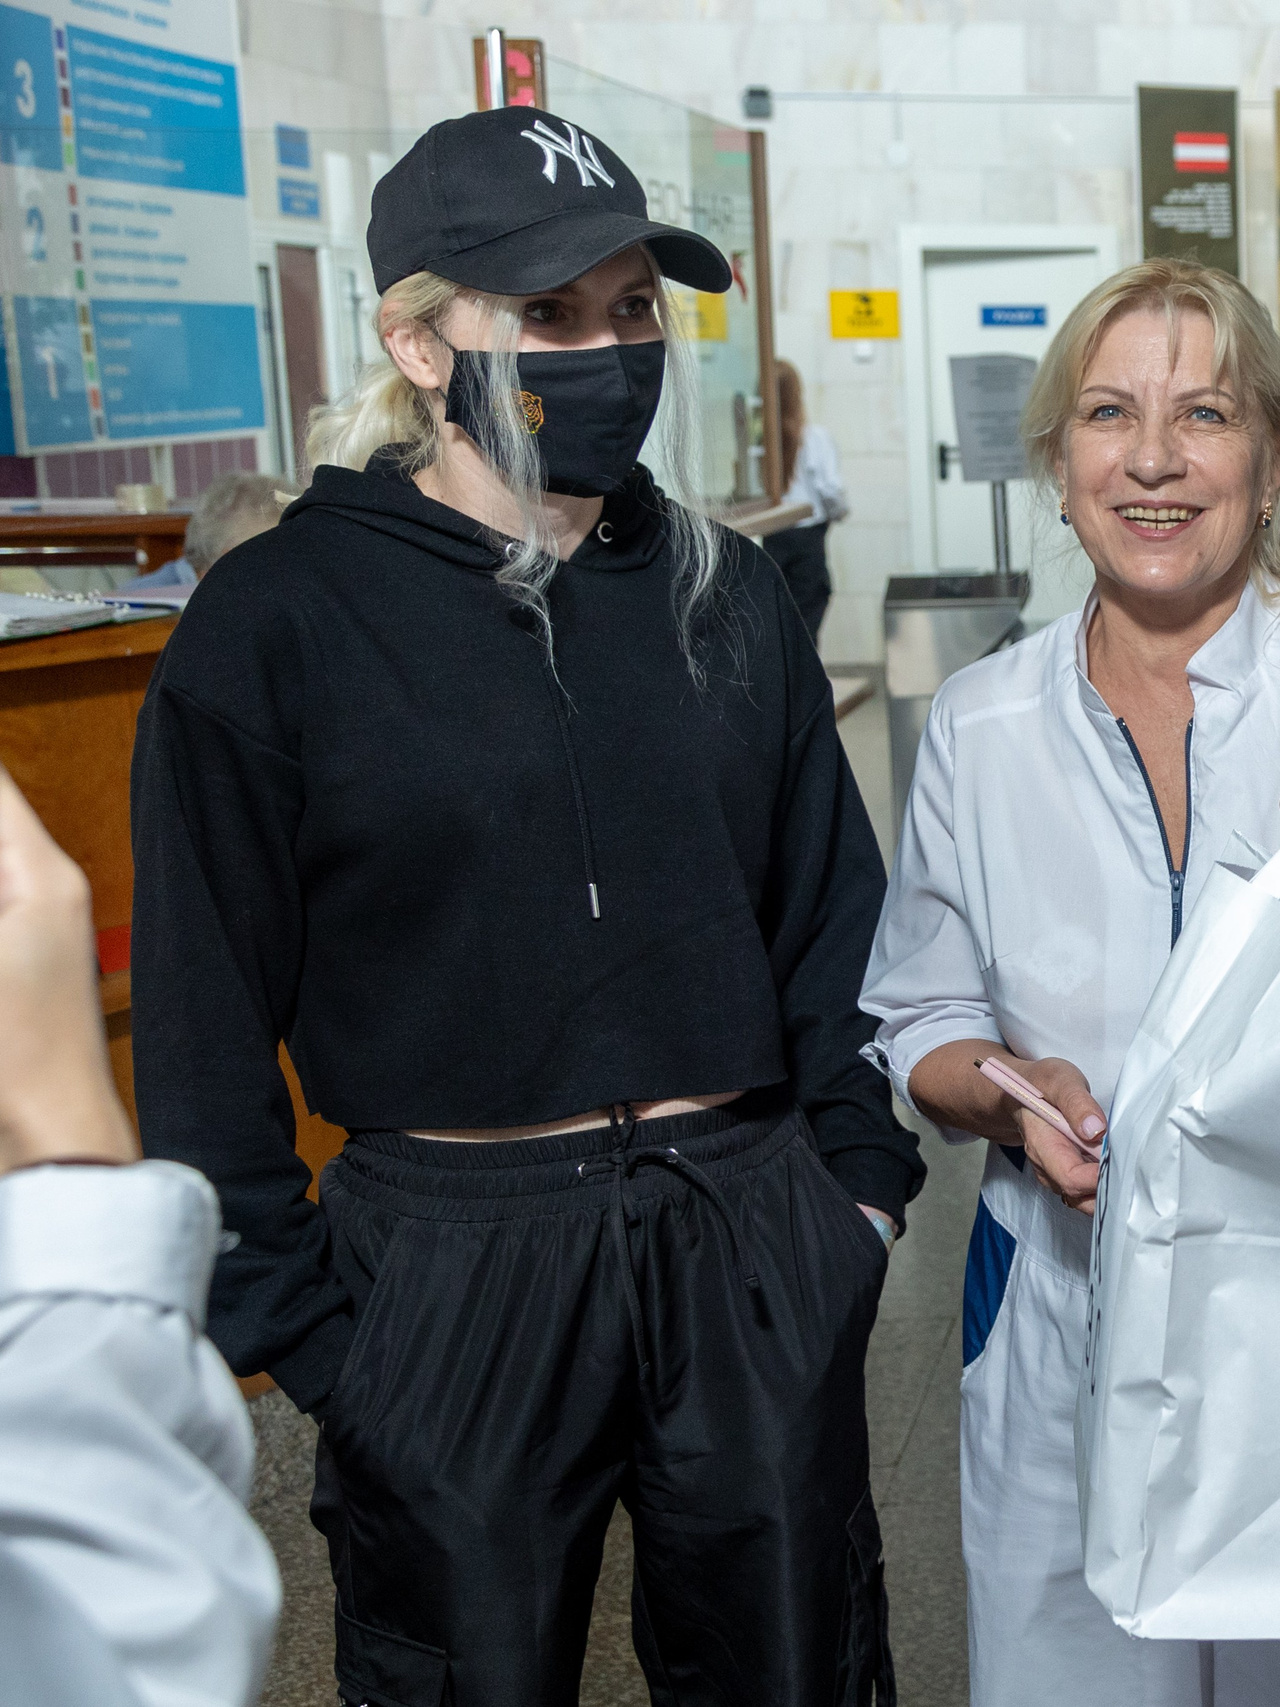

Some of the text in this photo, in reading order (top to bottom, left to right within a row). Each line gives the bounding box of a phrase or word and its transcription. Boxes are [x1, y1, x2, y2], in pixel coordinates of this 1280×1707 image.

[14, 59, 36, 119] 3
[520, 119, 616, 189] NY
[26, 206, 47, 262] 2
[42, 346, 58, 399] 1
